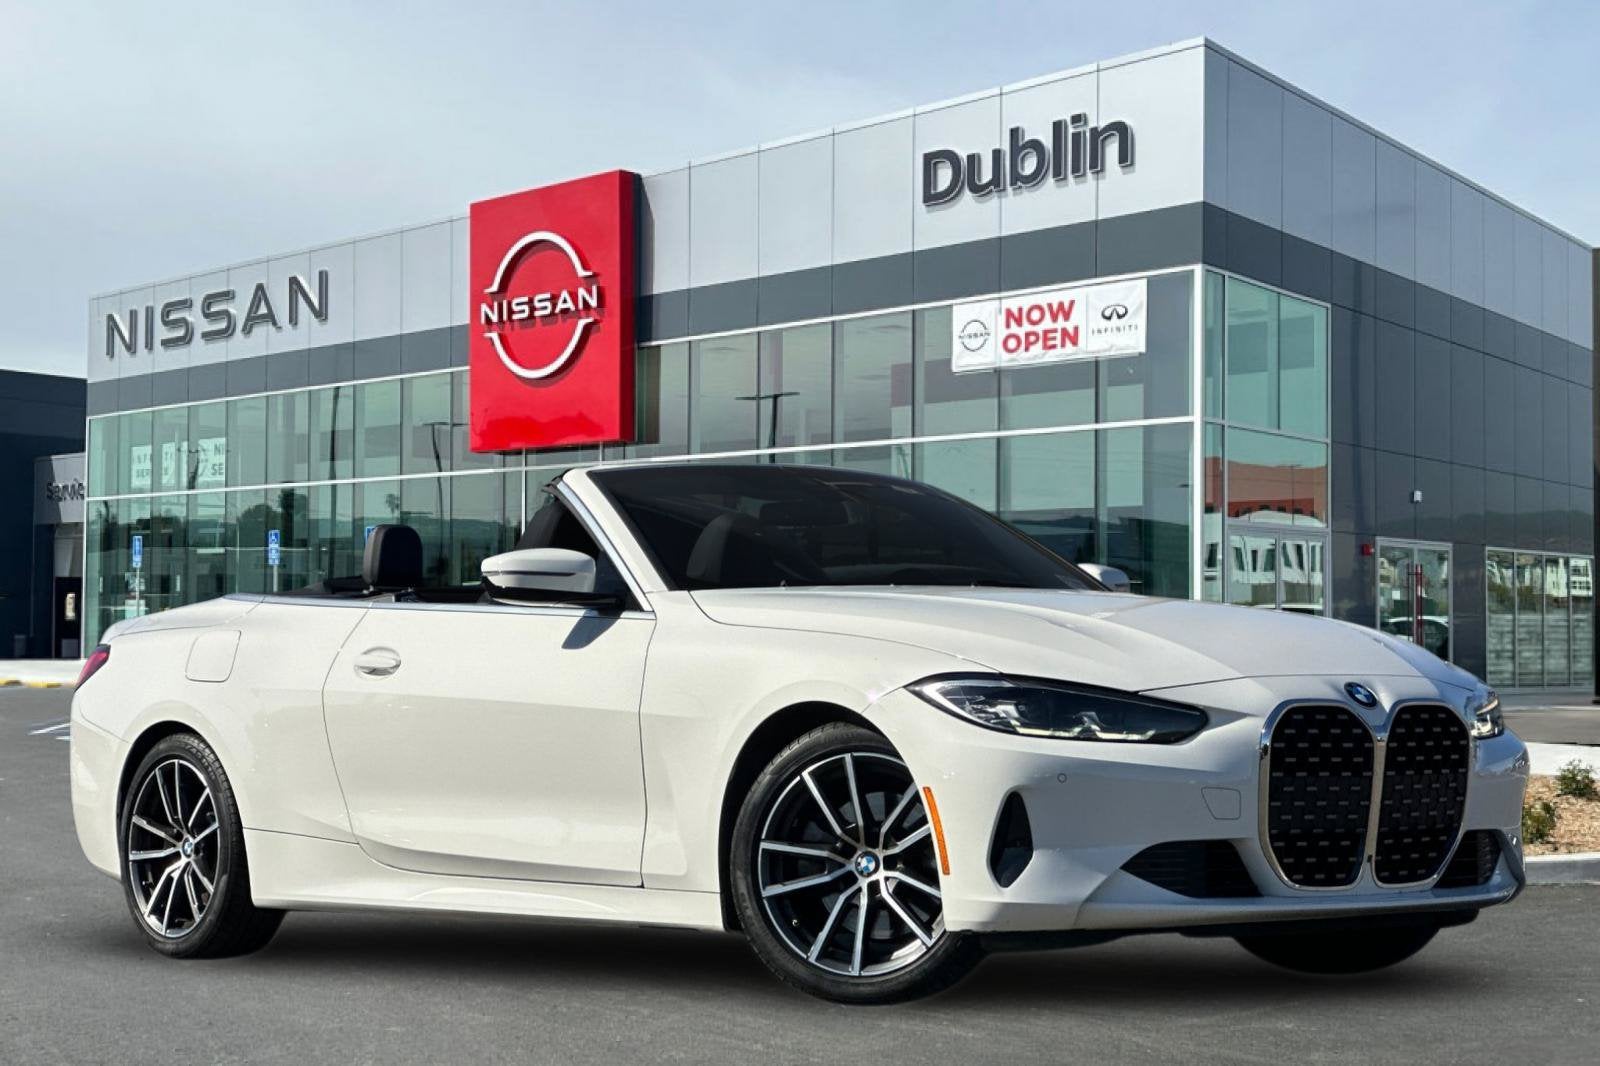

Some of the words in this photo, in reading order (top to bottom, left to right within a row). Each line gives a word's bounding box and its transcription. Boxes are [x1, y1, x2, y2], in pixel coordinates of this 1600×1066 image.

[923, 112, 1133, 206] Dublin
[106, 269, 328, 358] NISSAN
[480, 285, 598, 325] NISSAN
[1004, 299, 1076, 329] NOW
[1002, 325, 1080, 353] OPEN
[1091, 324, 1138, 336] INFINITI
